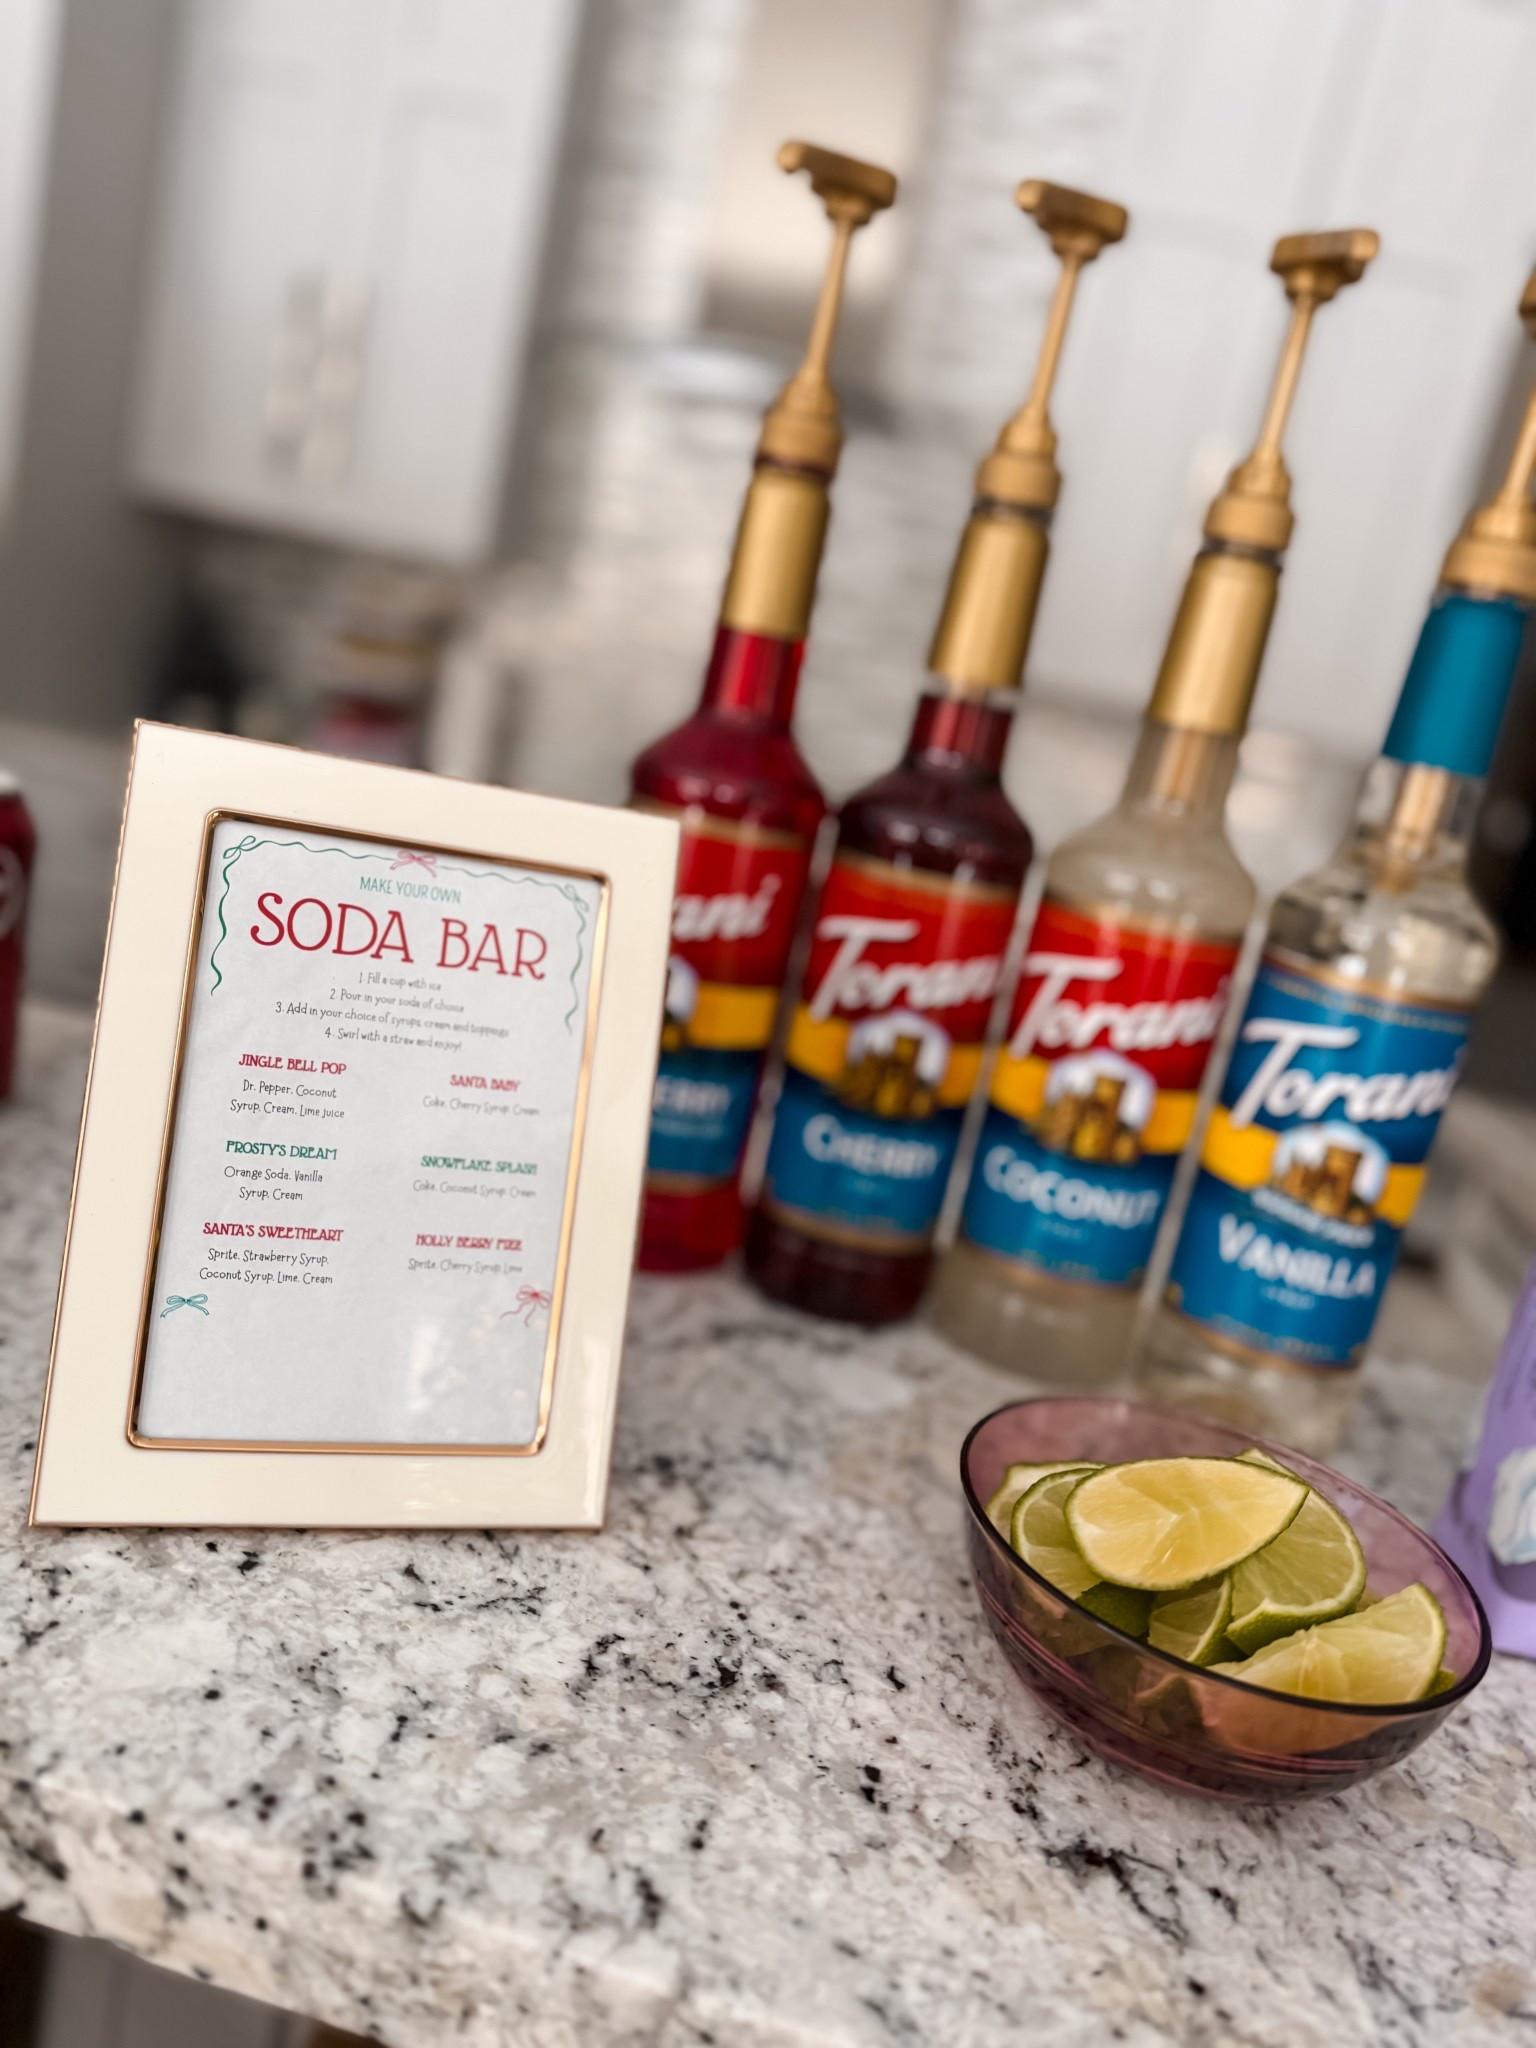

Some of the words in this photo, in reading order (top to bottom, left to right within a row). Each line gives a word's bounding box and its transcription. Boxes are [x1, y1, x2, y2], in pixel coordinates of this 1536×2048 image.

[359, 876, 392, 894] MAKE
[396, 881, 430, 899] YOUR
[430, 886, 462, 904] OWN
[250, 892, 414, 963] SODA
[436, 917, 547, 980] BAR
[808, 914, 1001, 1023] Toran
[367, 971, 381, 985] Fill
[382, 977, 388, 985] a
[389, 978, 406, 990] cup
[408, 977, 427, 990] with
[329, 988, 338, 1000] 2.
[340, 988, 362, 1001] Pour
[364, 993, 373, 1003] in
[375, 994, 396, 1007] your
[399, 995, 420, 1009] soda
[422, 997, 434, 1009] of
[434, 998, 464, 1013] choice
[275, 1001, 285, 1014] 3.
[286, 1002, 308, 1015] Add
[309, 1007, 318, 1016] in
[320, 1009, 343, 1020] your
[344, 1007, 376, 1022] choice
[378, 1011, 391, 1023] of
[453, 1020, 469, 1033] and
[324, 1026, 335, 1039] 4.
[337, 1027, 360, 1040] Swirl
[361, 1029, 380, 1042] with
[382, 1034, 388, 1042] a
[390, 1033, 414, 1045] straw
[416, 1034, 433, 1047] and
[238, 1053, 284, 1070] JINGLE
[287, 1058, 318, 1073] BELL
[320, 1061, 347, 1075] POP
[242, 1078, 257, 1092] Dr.
[295, 1084, 337, 1099] Coconut
[449, 1073, 488, 1090] SANTA
[490, 1078, 522, 1093] BABY
[299, 1104, 320, 1117] Lime
[449, 1097, 481, 1115] Cherry
[225, 1140, 287, 1157] FROSTY'S
[289, 1145, 338, 1161] DREAM
[802, 1113, 939, 1180] CHERRY
[224, 1165, 263, 1181] Orange
[294, 1169, 323, 1182] Vanilla
[420, 1155, 492, 1172] SNOWFLAKE
[495, 1160, 538, 1176] SPLASH
[272, 1188, 303, 1201] Cream
[439, 1181, 478, 1195] Coconut
[983, 1145, 1160, 1230] COCONUT
[202, 1221, 255, 1237] SANTA'S
[257, 1225, 344, 1242] SWEETHEART
[415, 1233, 454, 1248] HOLLY
[456, 1235, 494, 1250] BERRY
[495, 1238, 523, 1252] FIZZ
[242, 1249, 298, 1266] Strawberry
[439, 1258, 472, 1275] Cherry
[1218, 1212, 1377, 1300] VANILLA
[199, 1267, 242, 1281] Coconut
[302, 1272, 333, 1285] Cream
